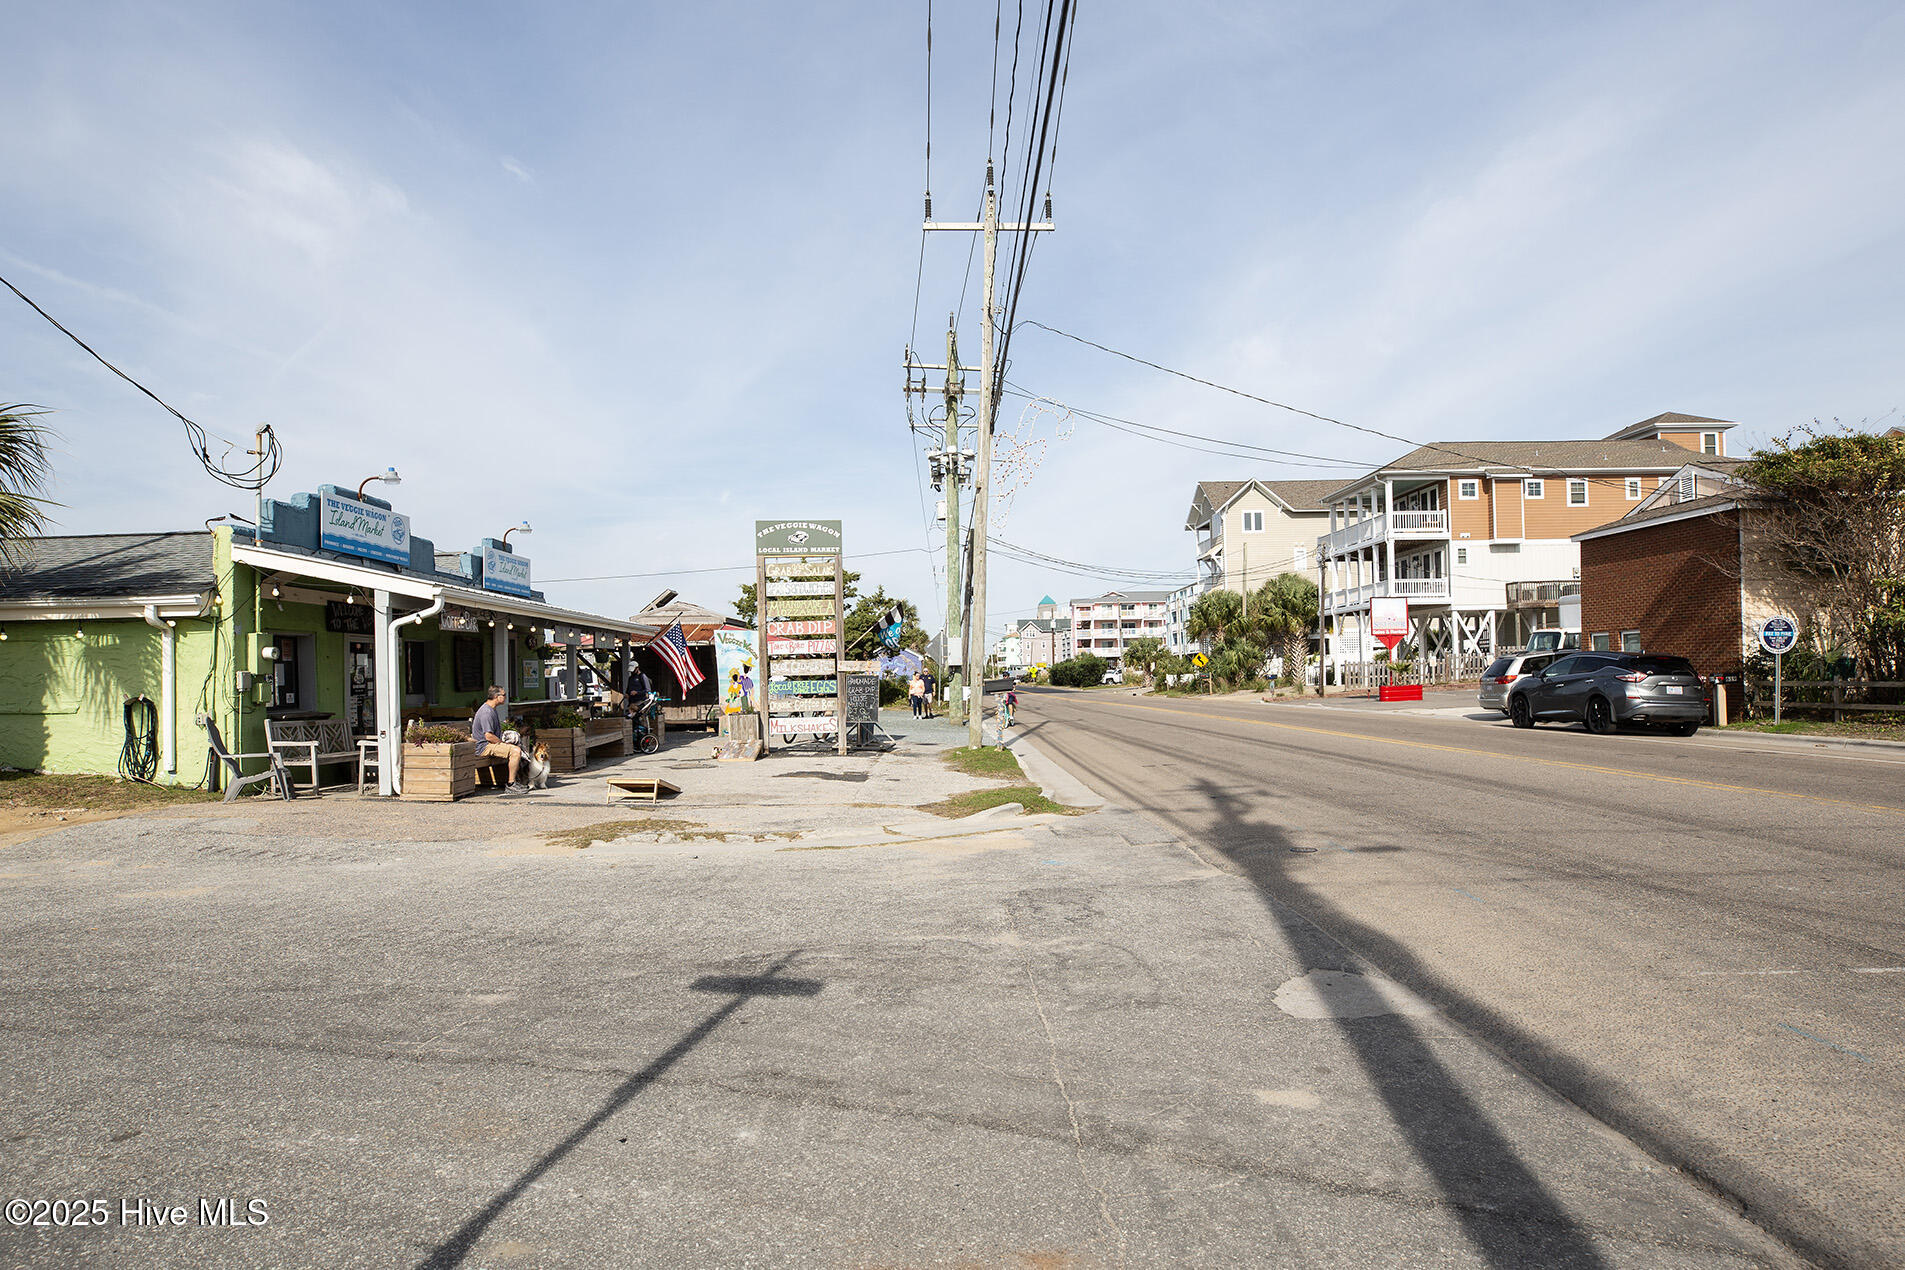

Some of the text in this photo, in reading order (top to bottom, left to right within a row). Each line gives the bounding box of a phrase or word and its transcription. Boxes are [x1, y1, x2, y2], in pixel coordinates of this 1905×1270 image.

[326, 498, 387, 522] THE VEGGIE WAGON
[329, 509, 357, 531] Island
[356, 517, 385, 537] Market
[757, 522, 841, 538] THE VEGGIE WAGON
[498, 561, 512, 576] Island
[768, 620, 832, 635] CRAB DIP
[716, 632, 759, 660] VEGGIE WAGON
[808, 640, 836, 653] PIZZAS
[769, 681, 792, 694] Local
[811, 680, 837, 693] EGGS
[794, 699, 820, 711] Coffee
[822, 699, 835, 710] Bar
[770, 718, 837, 734] MILKSHAKES
